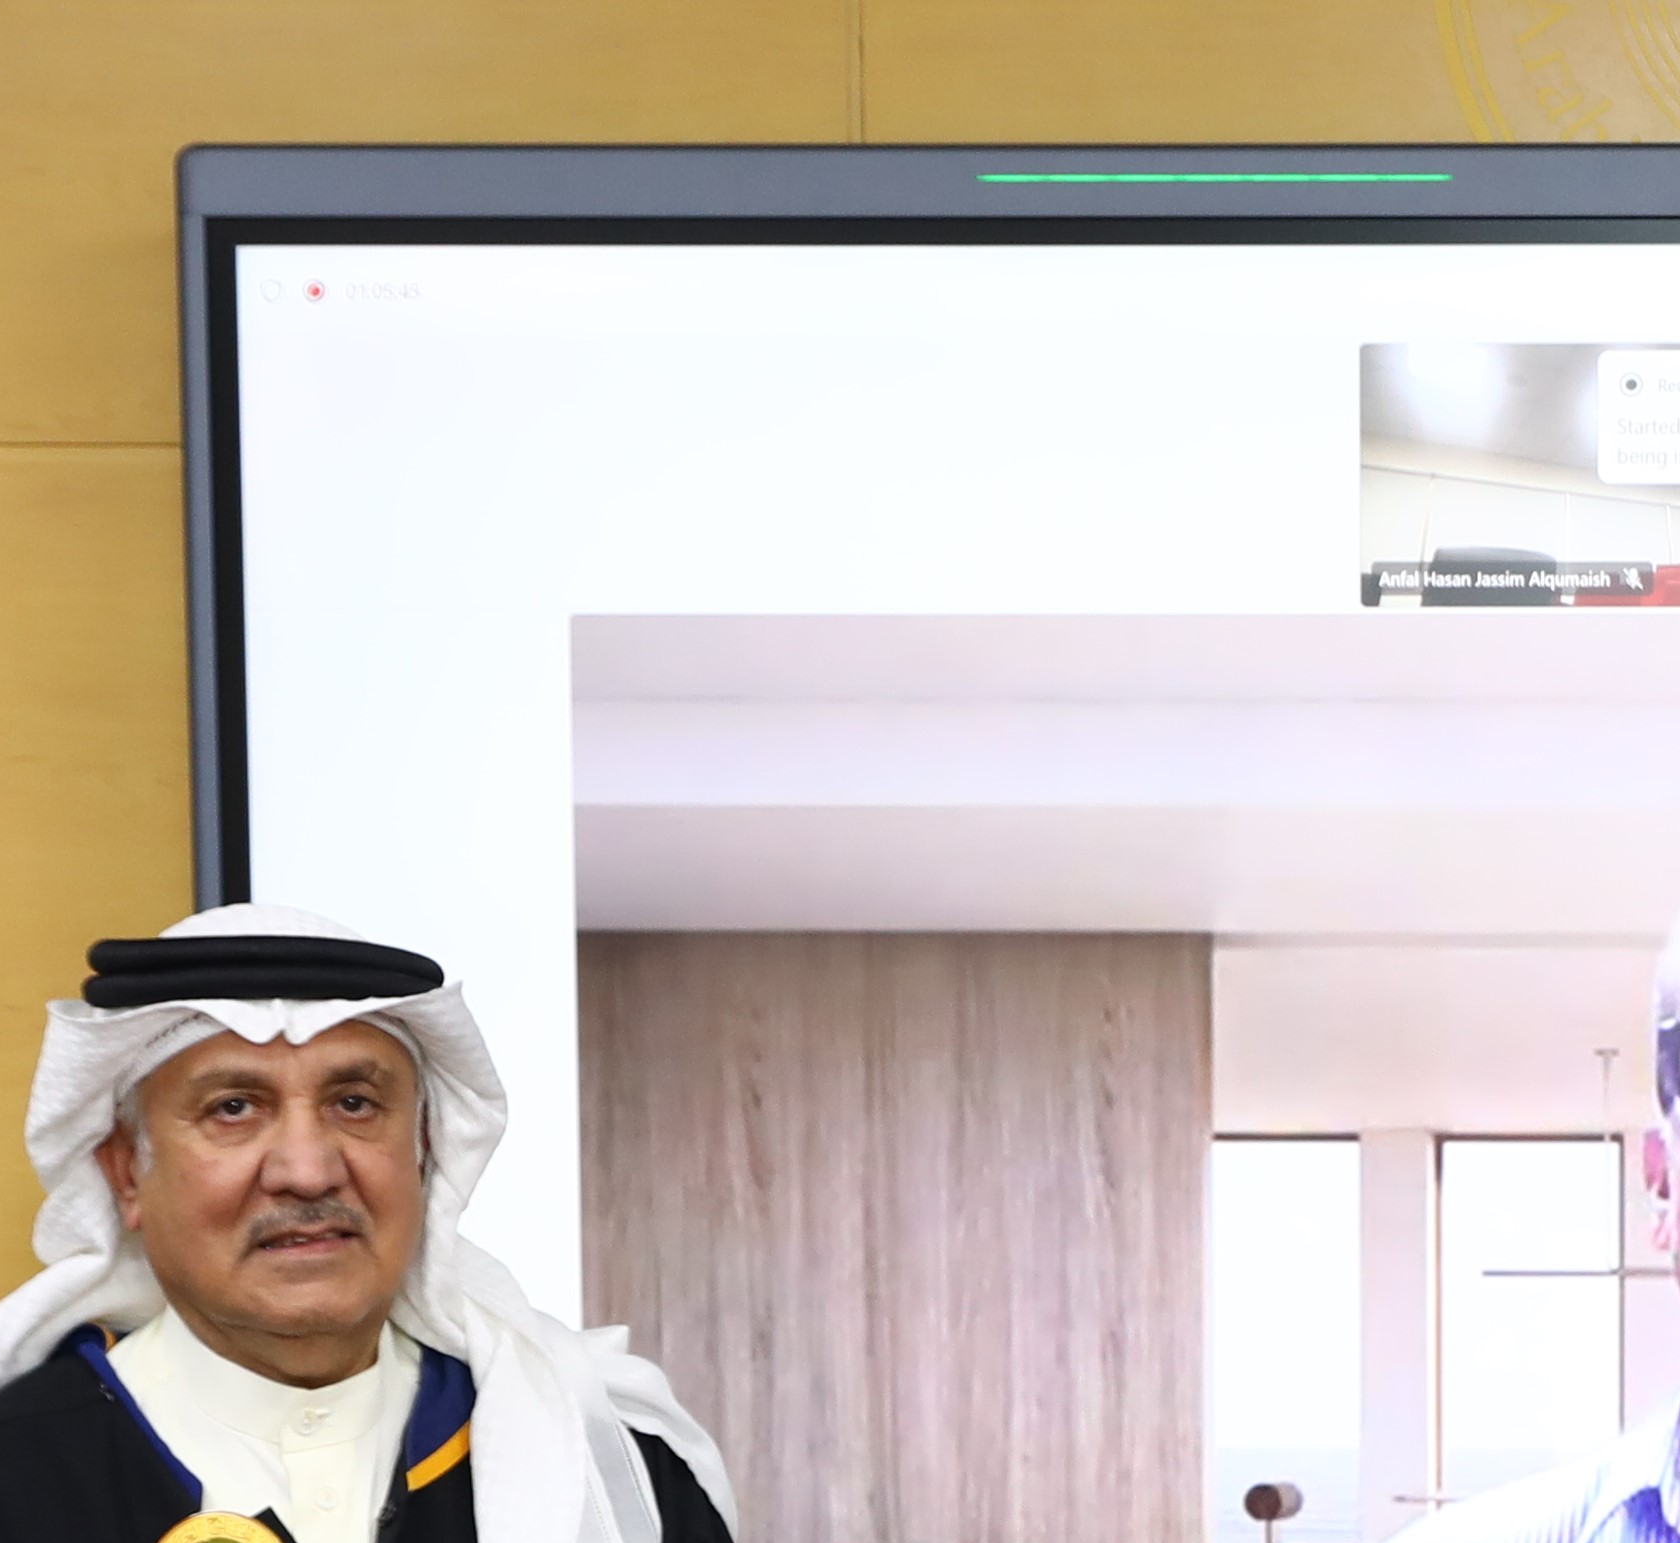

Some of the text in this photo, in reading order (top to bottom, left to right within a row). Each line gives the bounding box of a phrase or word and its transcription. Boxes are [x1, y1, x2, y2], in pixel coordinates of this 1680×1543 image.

[1617, 417, 1680, 435] Started
[1617, 447, 1668, 467] being
[1378, 570, 1611, 591] Anfal Hasan Jassim Alqumaish
